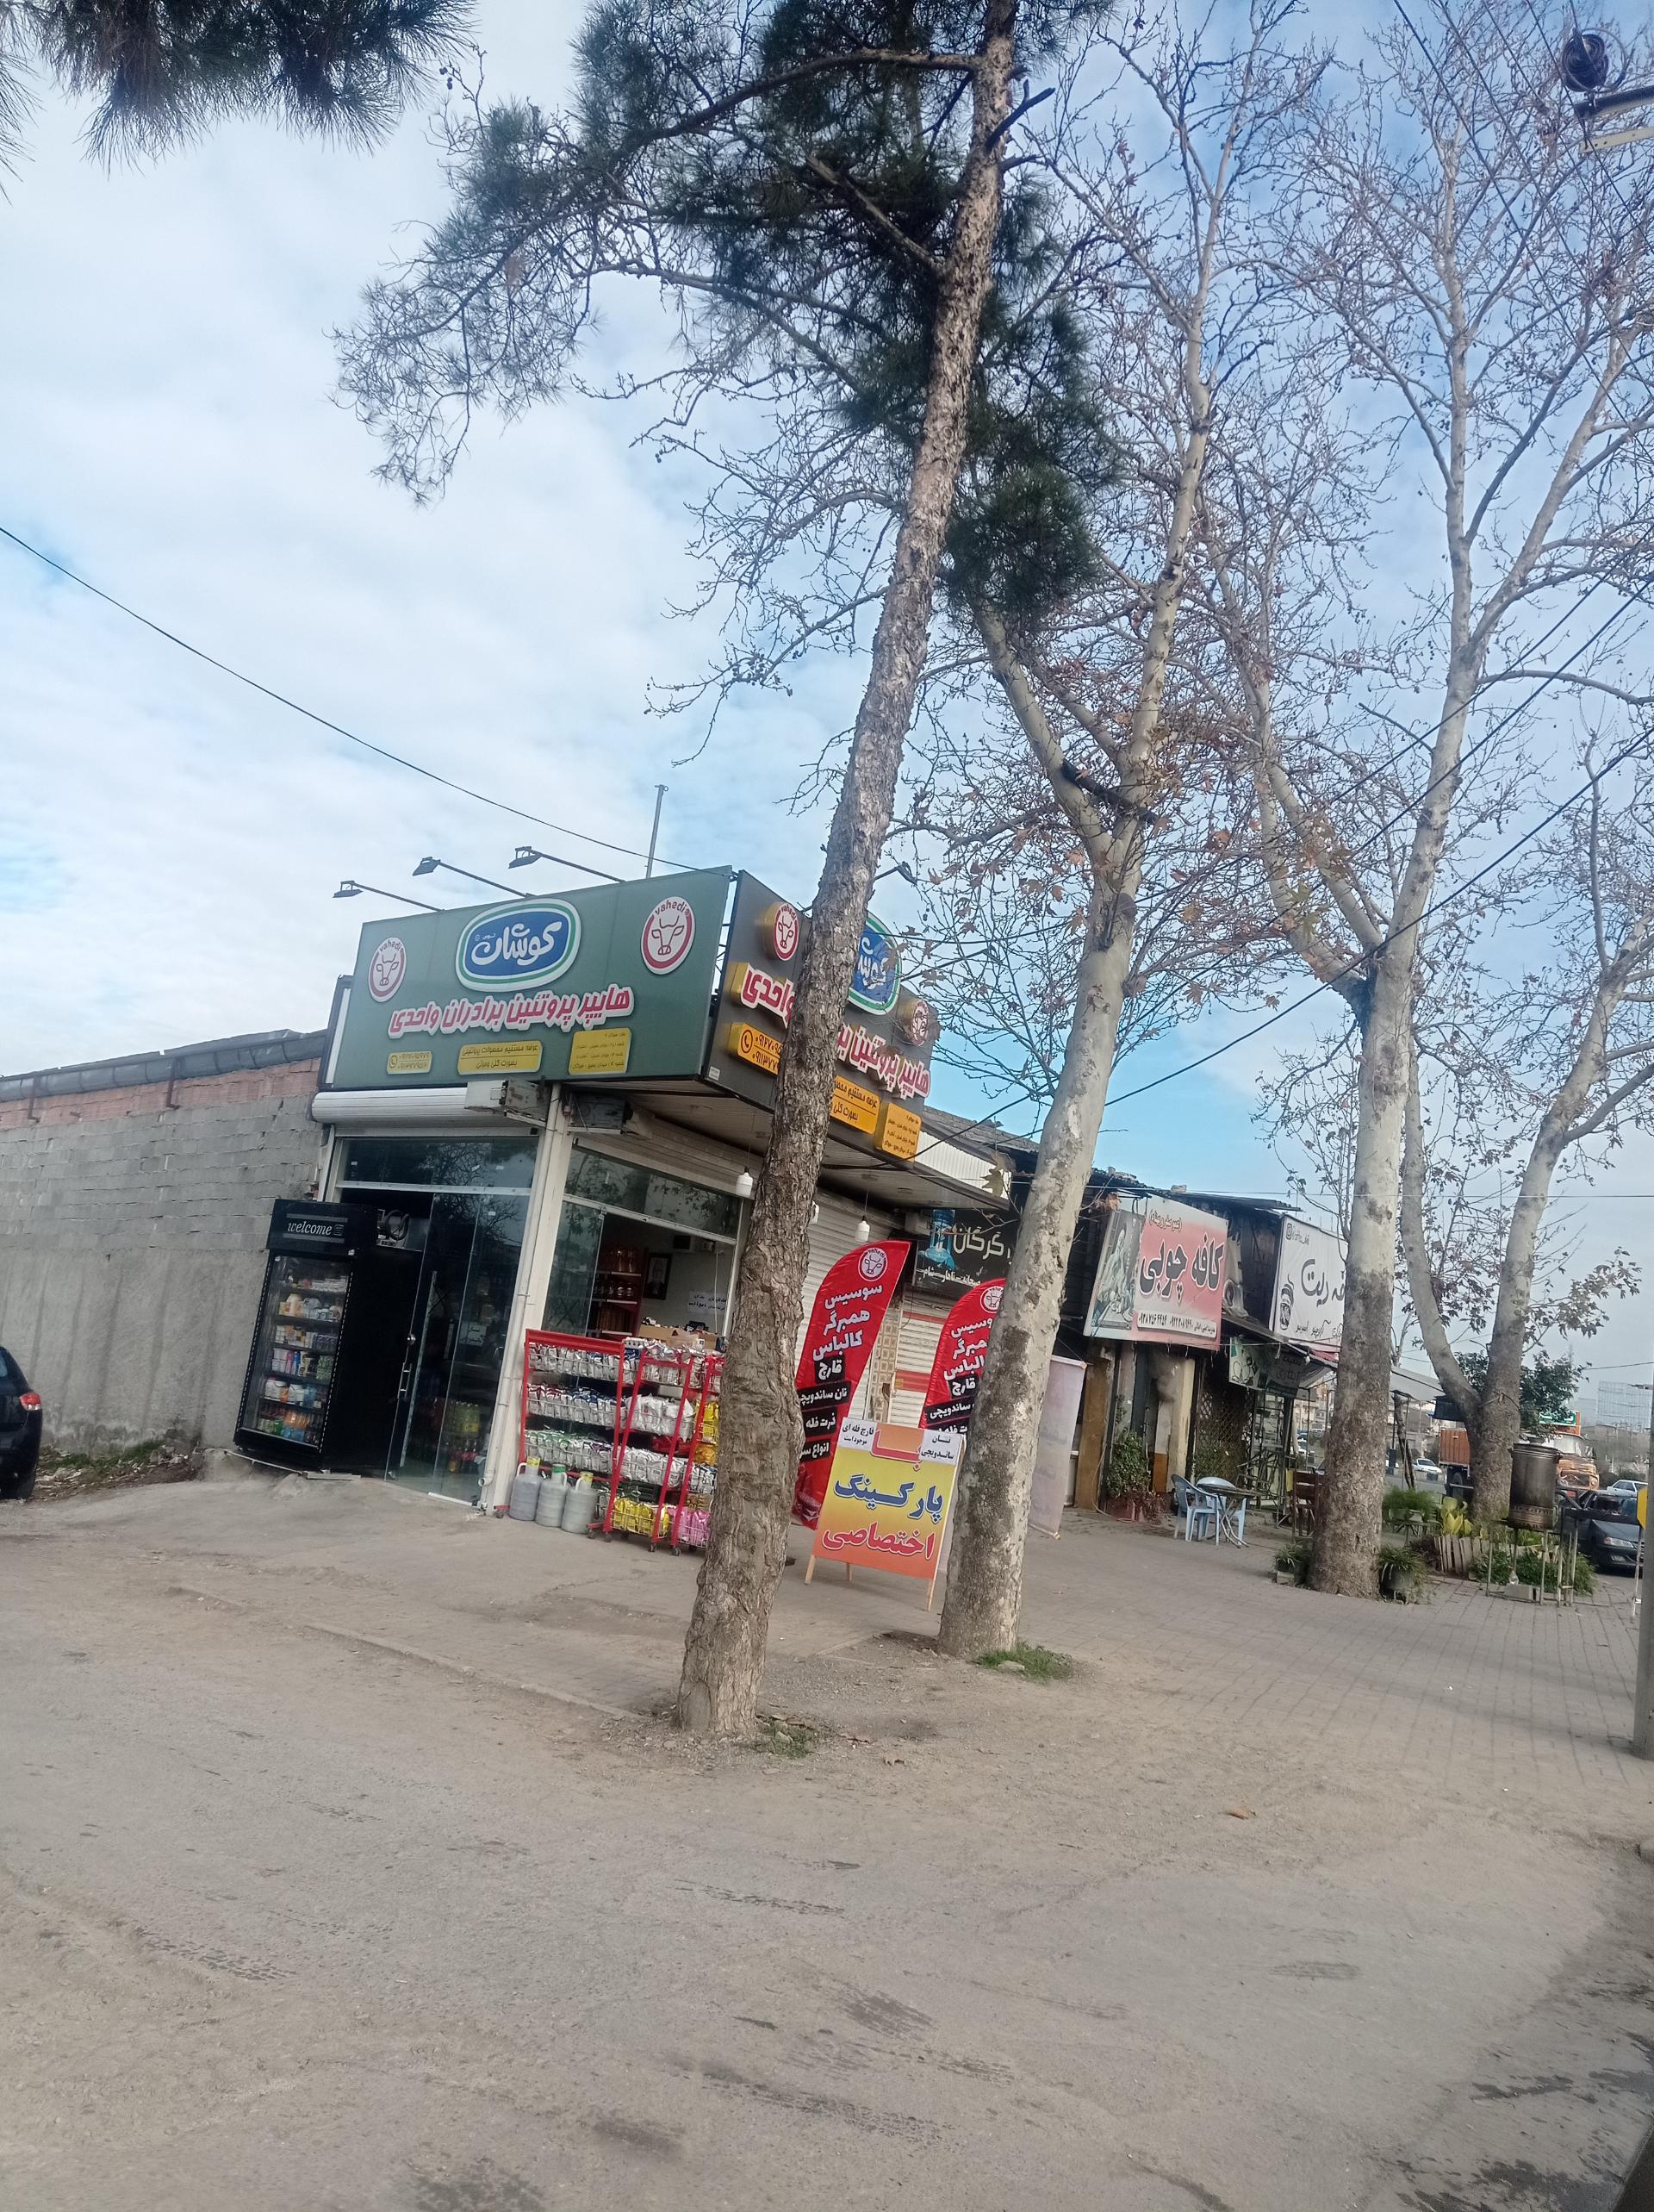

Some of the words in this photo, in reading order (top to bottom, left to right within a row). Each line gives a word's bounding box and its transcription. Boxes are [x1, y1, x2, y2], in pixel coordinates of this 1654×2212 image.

[389, 1002, 440, 1034] واحدی
[442, 998, 505, 1029] برادران
[507, 994, 575, 1026] پروتئین
[577, 987, 630, 1025] هایپر
[287, 1220, 333, 1236] welcome
[1139, 1239, 1189, 1304] چوبی
[1191, 1232, 1225, 1291] کافه
[824, 1285, 883, 1309] سوسیس
[823, 1310, 871, 1336] همبرگر
[951, 1318, 993, 1338] وسیس
[812, 1330, 863, 1361] کالباس
[953, 1337, 988, 1360] مبرگر
[818, 1359, 843, 1380] قارچ
[943, 1355, 985, 1380] الباس
[799, 1390, 834, 1405] ساندویچ
[834, 1387, 848, 1400] نان
[952, 1377, 976, 1396] قارچ
[805, 1417, 819, 1428] فله
[820, 1412, 836, 1430] ذرت
[860, 1426, 874, 1437] قارچ
[811, 1442, 830, 1458] انواع
[833, 1474, 944, 1524] پارکینگ
[821, 1520, 937, 1561] اختصاصی
